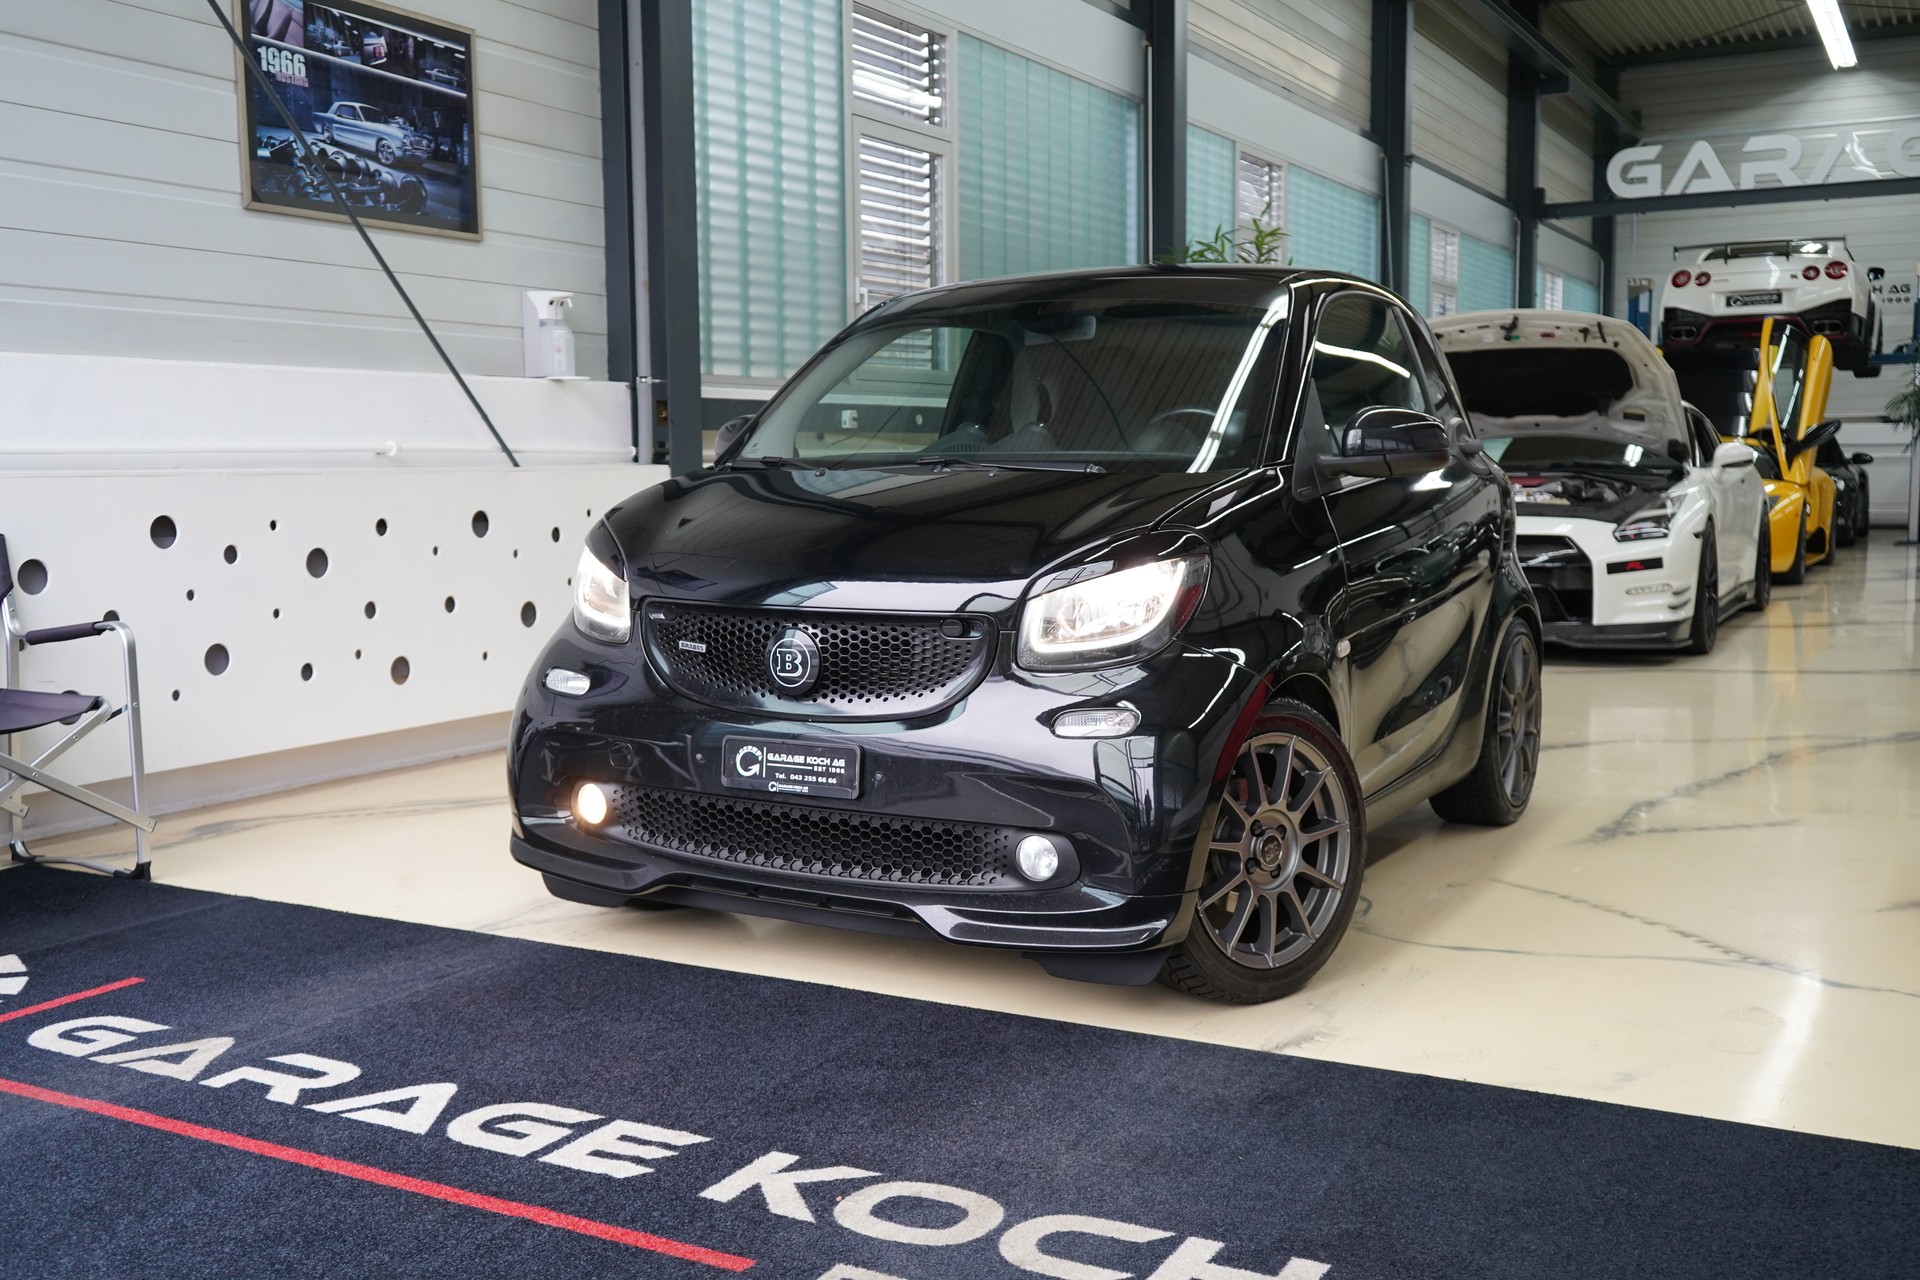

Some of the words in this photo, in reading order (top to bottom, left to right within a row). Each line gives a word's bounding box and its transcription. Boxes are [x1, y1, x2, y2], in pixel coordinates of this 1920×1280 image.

[257, 45, 307, 78] 1966
[776, 648, 803, 676] B
[767, 753, 805, 763] GARAGE
[806, 756, 830, 765] KOCH
[832, 758, 845, 767] AG
[27, 1015, 712, 1179] GARAGE
